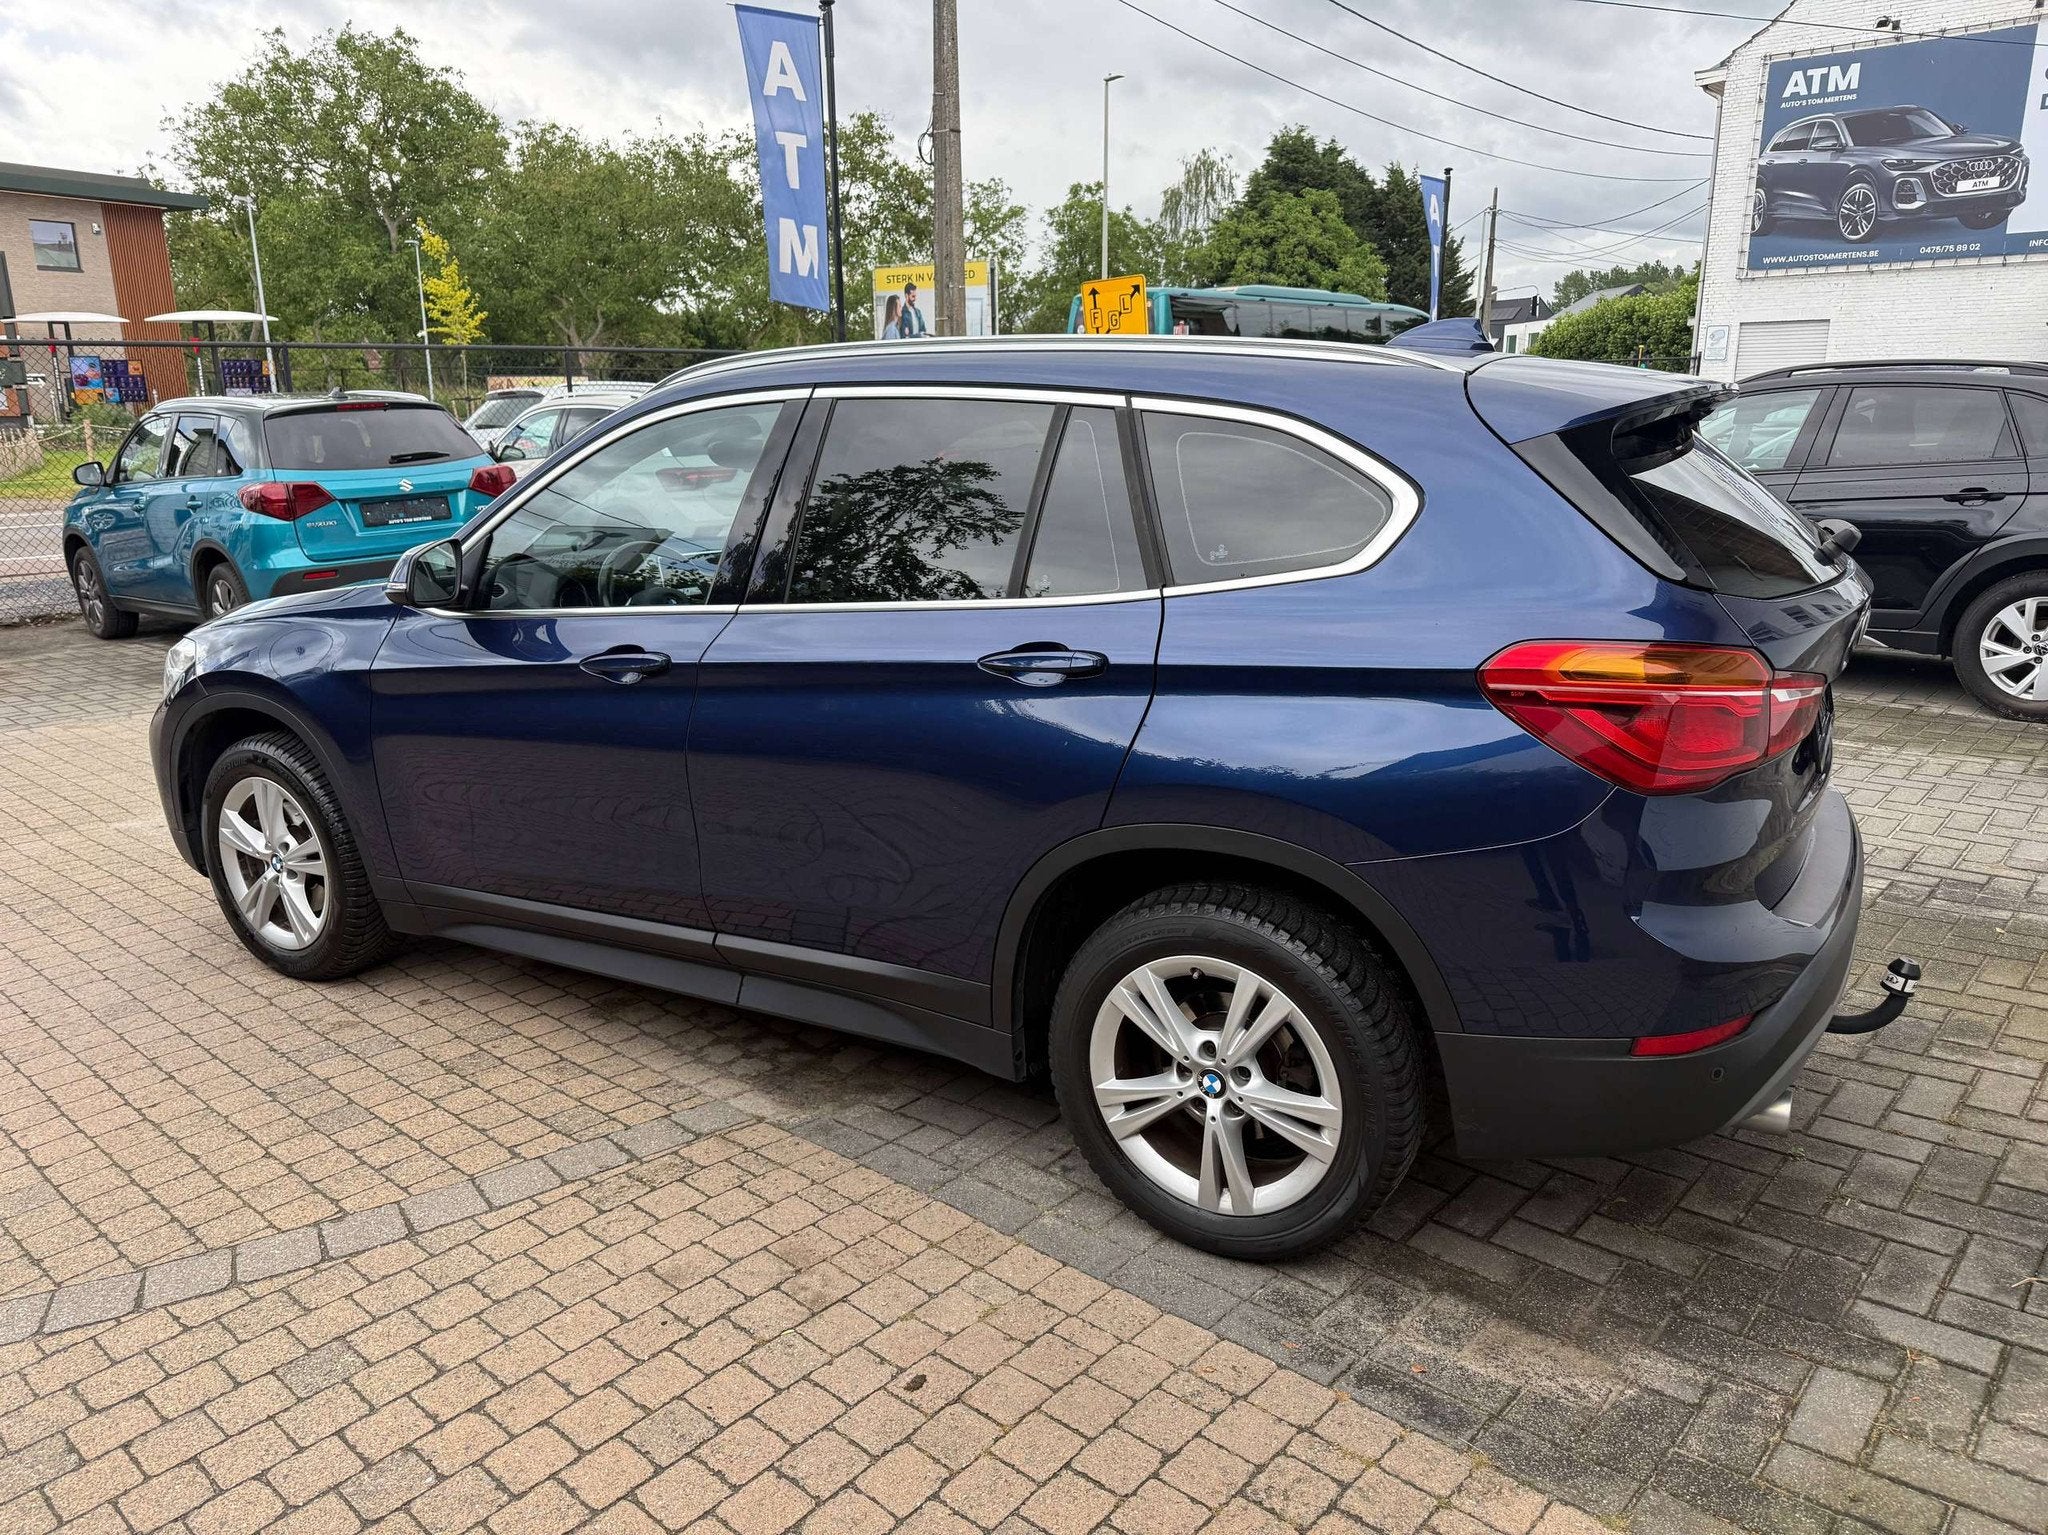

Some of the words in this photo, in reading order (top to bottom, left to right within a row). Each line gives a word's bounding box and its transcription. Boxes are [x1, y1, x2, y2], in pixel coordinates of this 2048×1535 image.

[1782, 62, 1861, 98] ATM
[1780, 99, 1807, 109] AUTO'S
[1807, 97, 1824, 106] TOM
[1824, 93, 1858, 104] MERTENS
[763, 40, 819, 280] ATM
[1972, 180, 1989, 188] ATM
[1956, 244, 1968, 252] 89
[1969, 243, 1981, 251] 02
[1762, 249, 1880, 264] WWW.AUTOSTOMMERTENS.BE
[886, 274, 914, 284] STERK
[915, 273, 925, 282] IN
[1122, 297, 1130, 312] L
[1093, 311, 1099, 323] F
[1110, 314, 1118, 328] G
